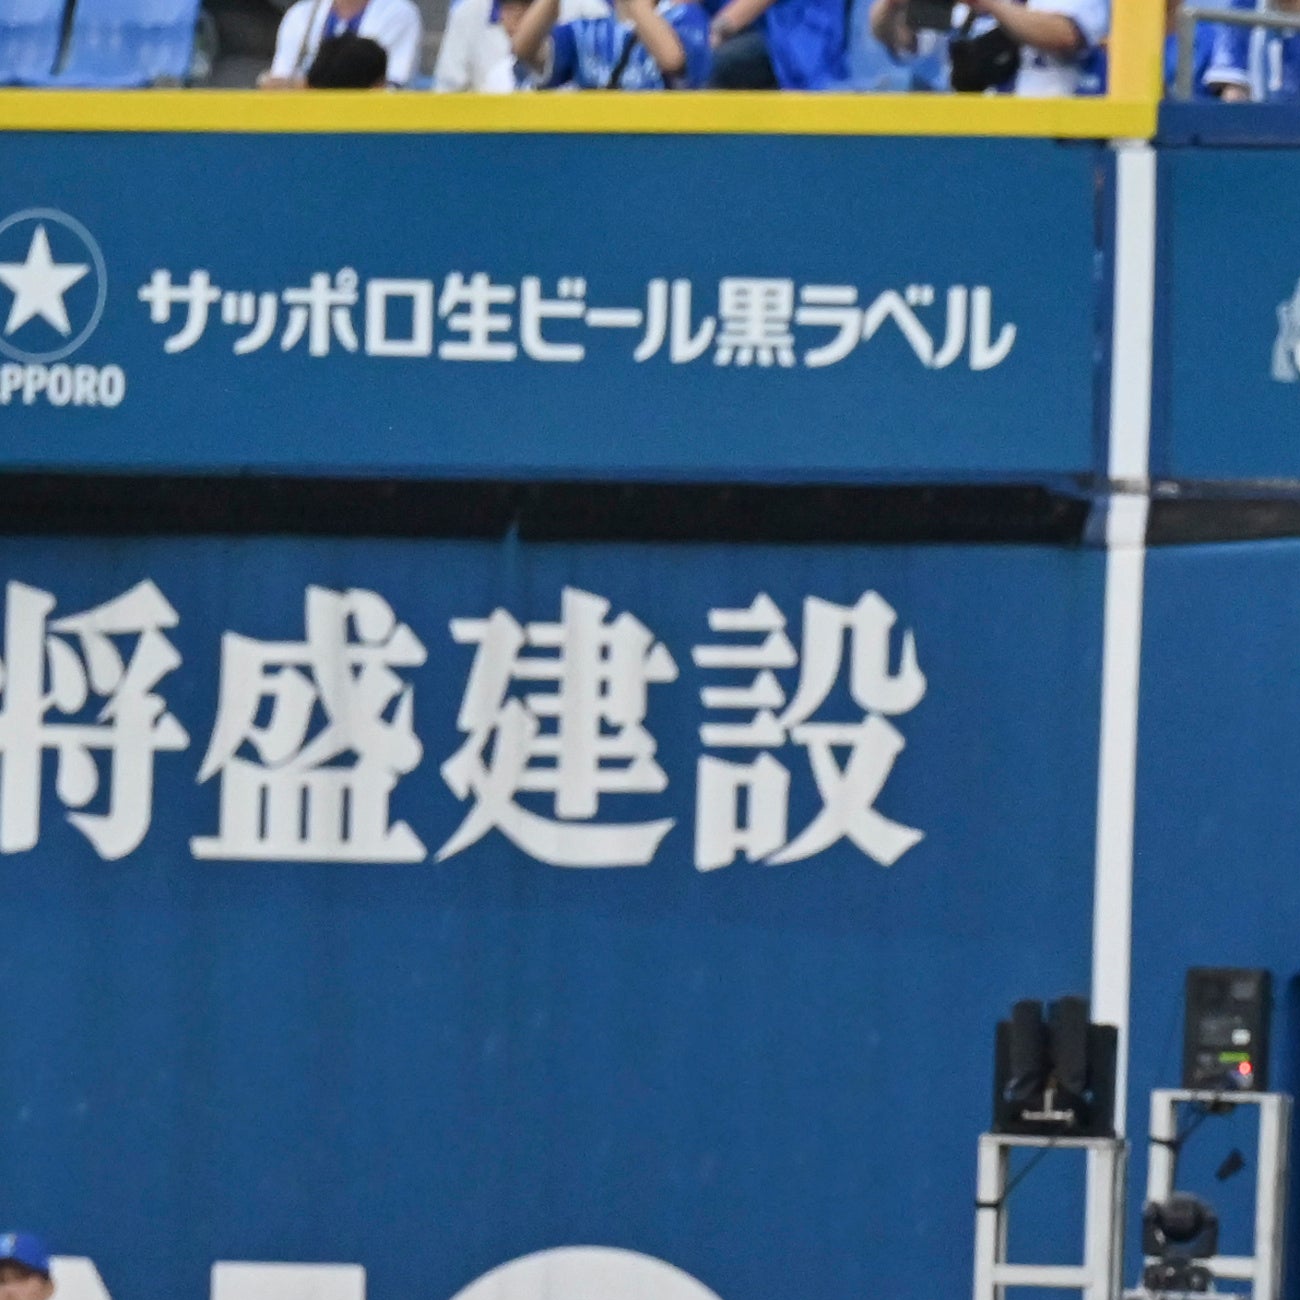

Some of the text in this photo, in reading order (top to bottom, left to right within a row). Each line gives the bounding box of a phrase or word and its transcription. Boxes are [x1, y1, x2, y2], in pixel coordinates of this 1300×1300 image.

[138, 266, 1016, 372] サッポロ生ビール黒ラベル
[0, 363, 125, 407] PPORO
